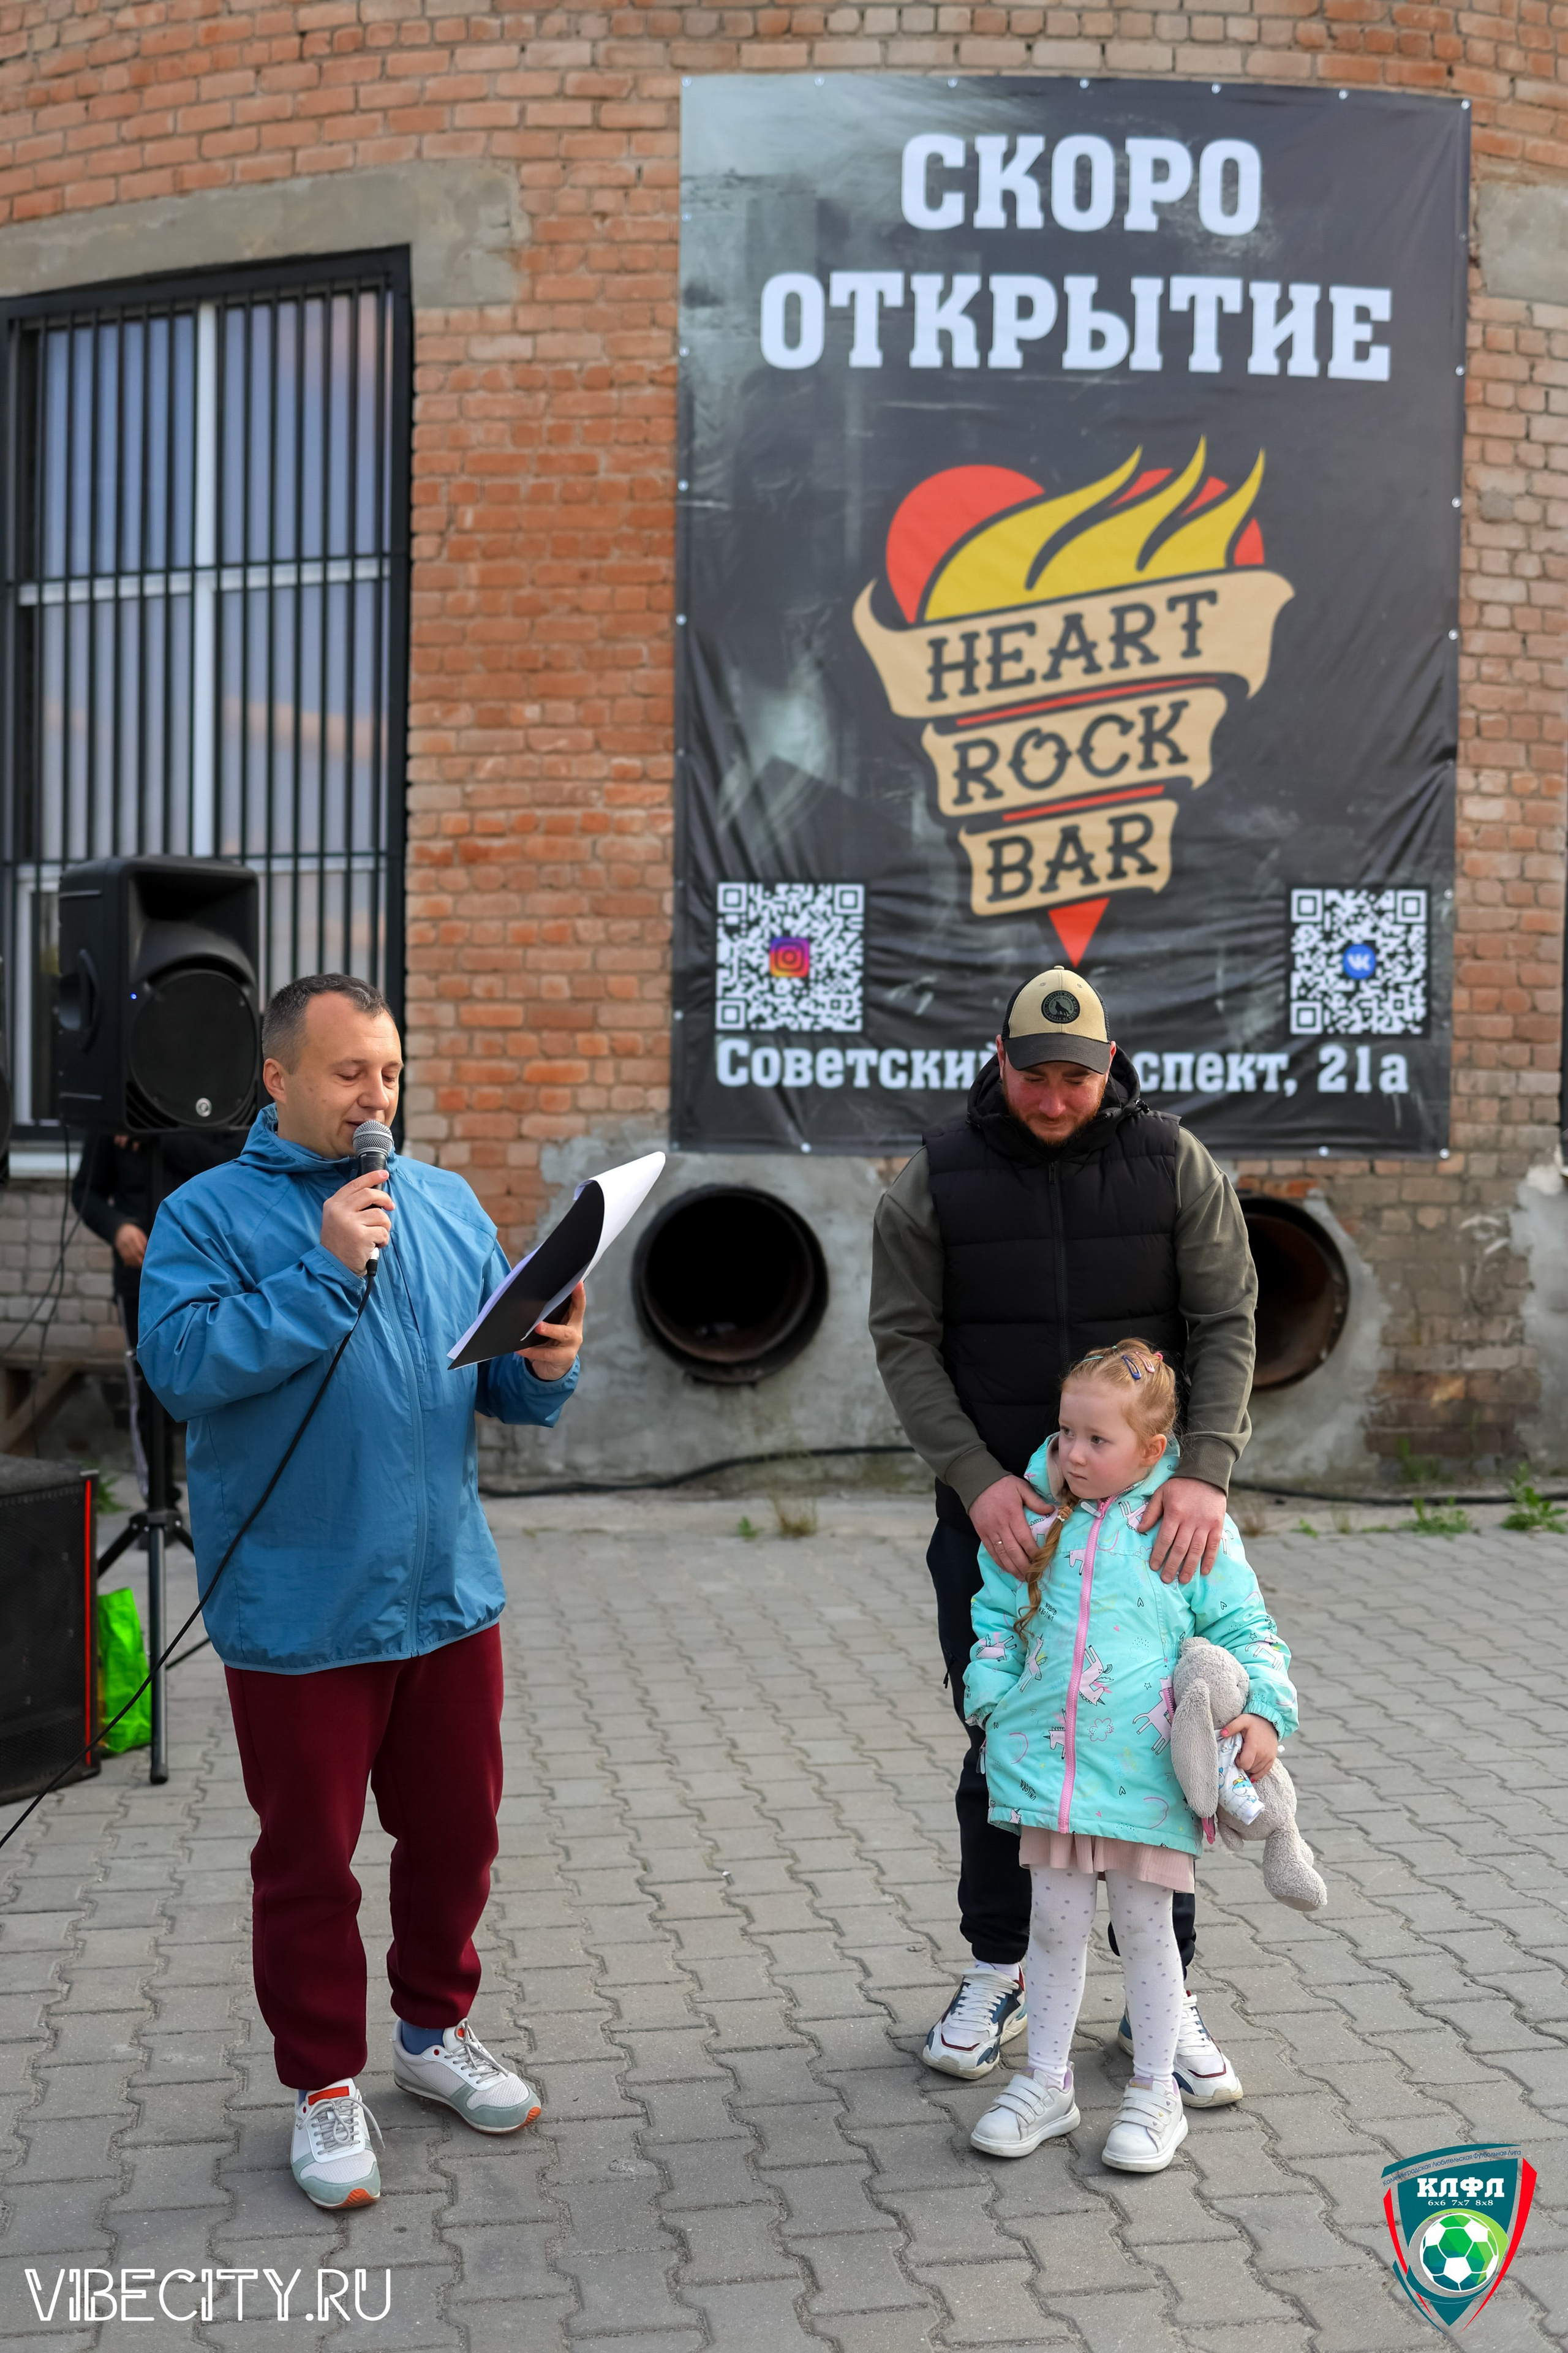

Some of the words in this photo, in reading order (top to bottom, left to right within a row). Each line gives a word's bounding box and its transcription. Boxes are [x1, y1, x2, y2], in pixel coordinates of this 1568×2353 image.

[900, 133, 1262, 236] СКОРО
[760, 271, 1392, 382] ОТКРЫТИЕ
[927, 590, 1218, 703] HEART
[952, 699, 1190, 806] ROCK
[986, 812, 1158, 903] BAR
[1132, 1051, 1298, 1097] спект,
